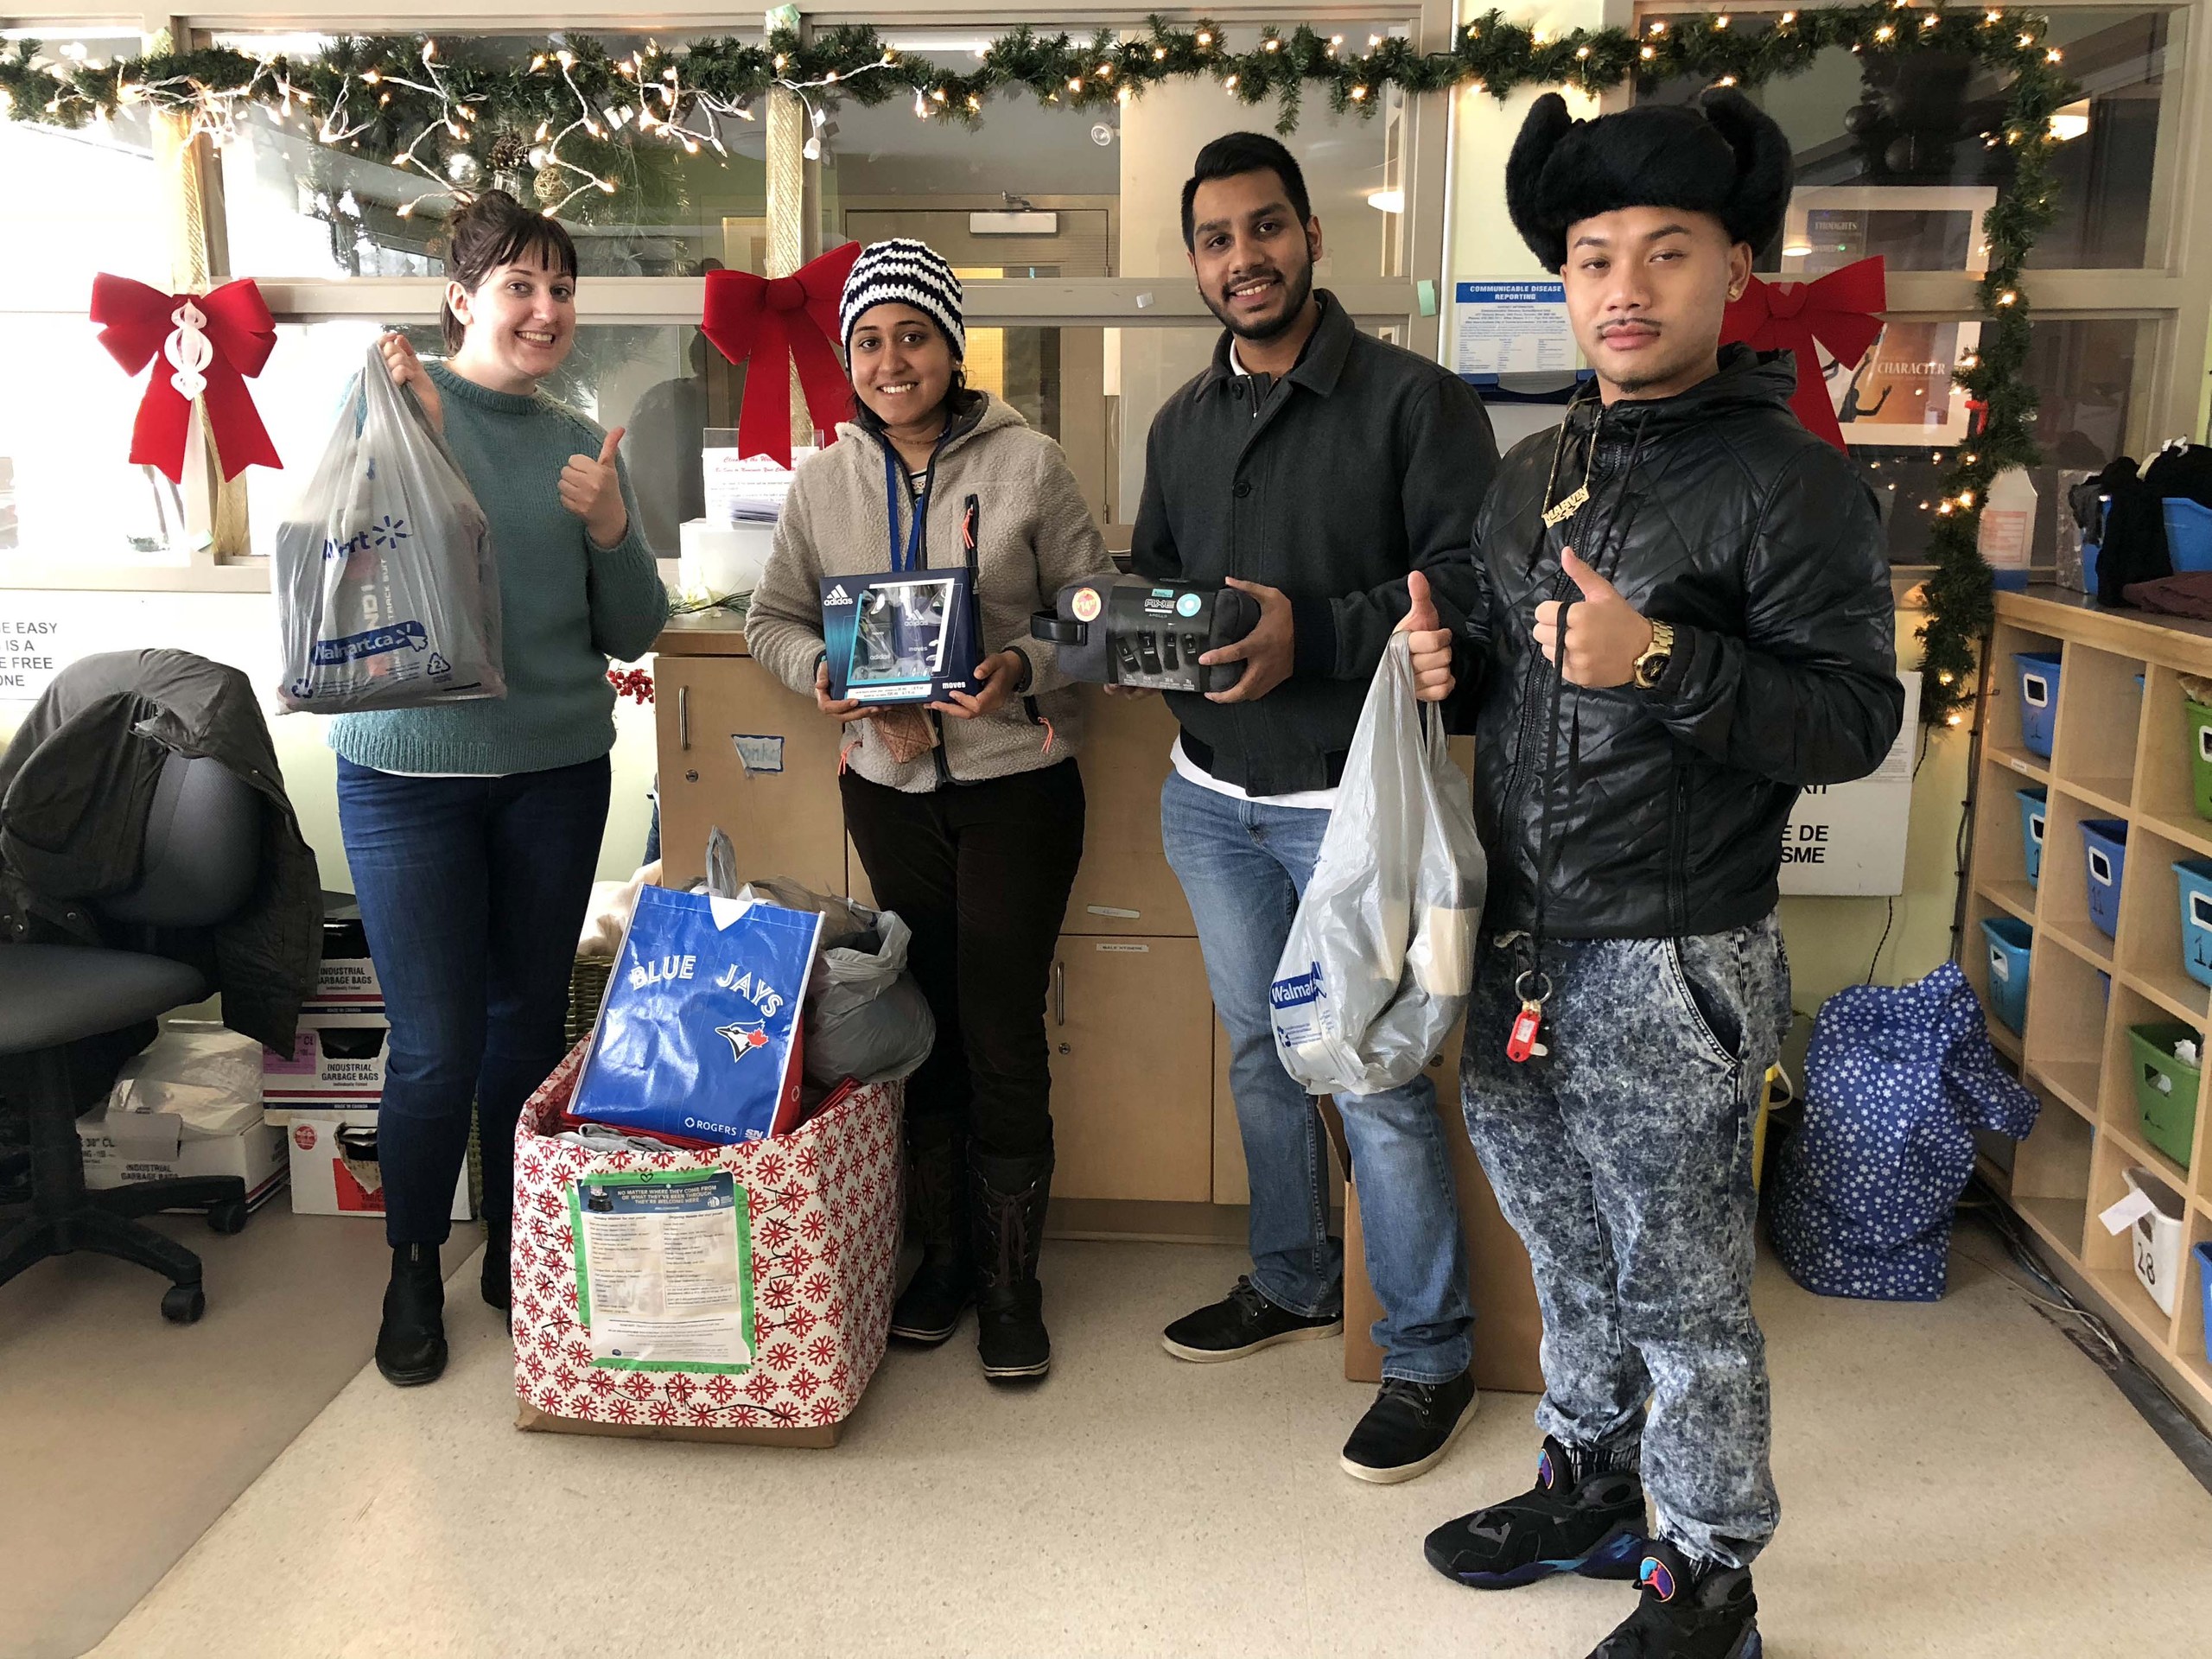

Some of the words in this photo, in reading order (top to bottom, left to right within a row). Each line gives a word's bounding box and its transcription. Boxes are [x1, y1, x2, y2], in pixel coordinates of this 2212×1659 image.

[1878, 362, 1945, 375] CHARACTER
[385, 585, 394, 620] TRACK
[823, 597, 853, 606] adidas
[1144, 599, 1175, 608] AXE
[16, 622, 57, 634] EASY
[6, 639, 19, 652] IS
[24, 639, 35, 652] A
[12, 657, 54, 669] FREE
[433, 660, 442, 669] 2
[942, 681, 966, 690] moves
[1799, 825, 1828, 842] DE
[630, 955, 696, 991] BLUE
[716, 963, 784, 1018] JAYS
[1272, 982, 1314, 1003] Walma
[321, 1072, 356, 1081] GARBAGE
[359, 1072, 378, 1081] BAGS
[696, 1120, 737, 1135] ROGERS
